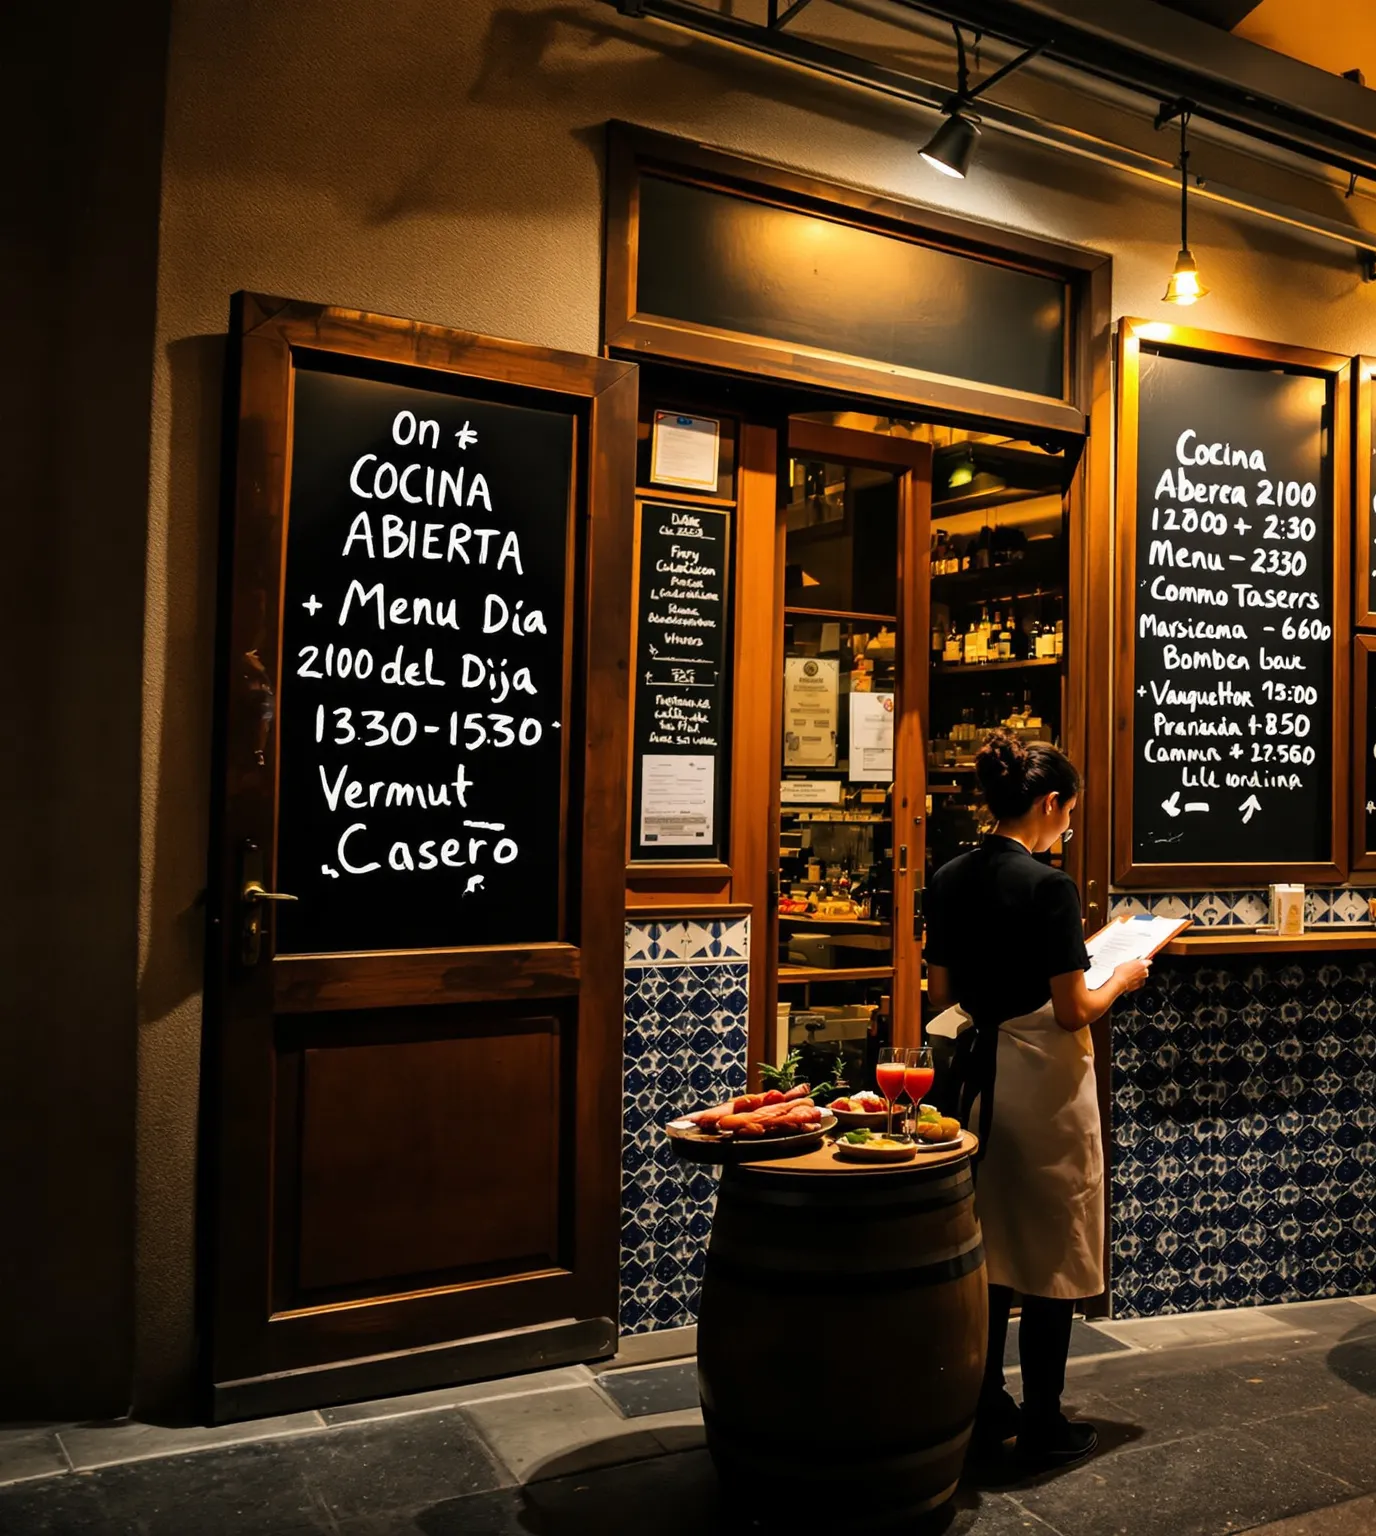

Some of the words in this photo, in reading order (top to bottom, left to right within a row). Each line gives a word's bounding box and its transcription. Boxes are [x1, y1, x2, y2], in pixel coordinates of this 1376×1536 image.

[392, 410, 440, 449] On
[1176, 429, 1267, 472] Cocina
[350, 453, 492, 511] COCINA
[1256, 479, 1317, 508] 2100
[342, 511, 523, 575] ABIERTA
[1263, 514, 1316, 542] 2:30
[1149, 540, 1225, 571] Menu
[338, 579, 460, 630] Menu
[297, 643, 373, 679] 2100
[319, 764, 474, 811] Vermut
[337, 823, 518, 874] Casero
